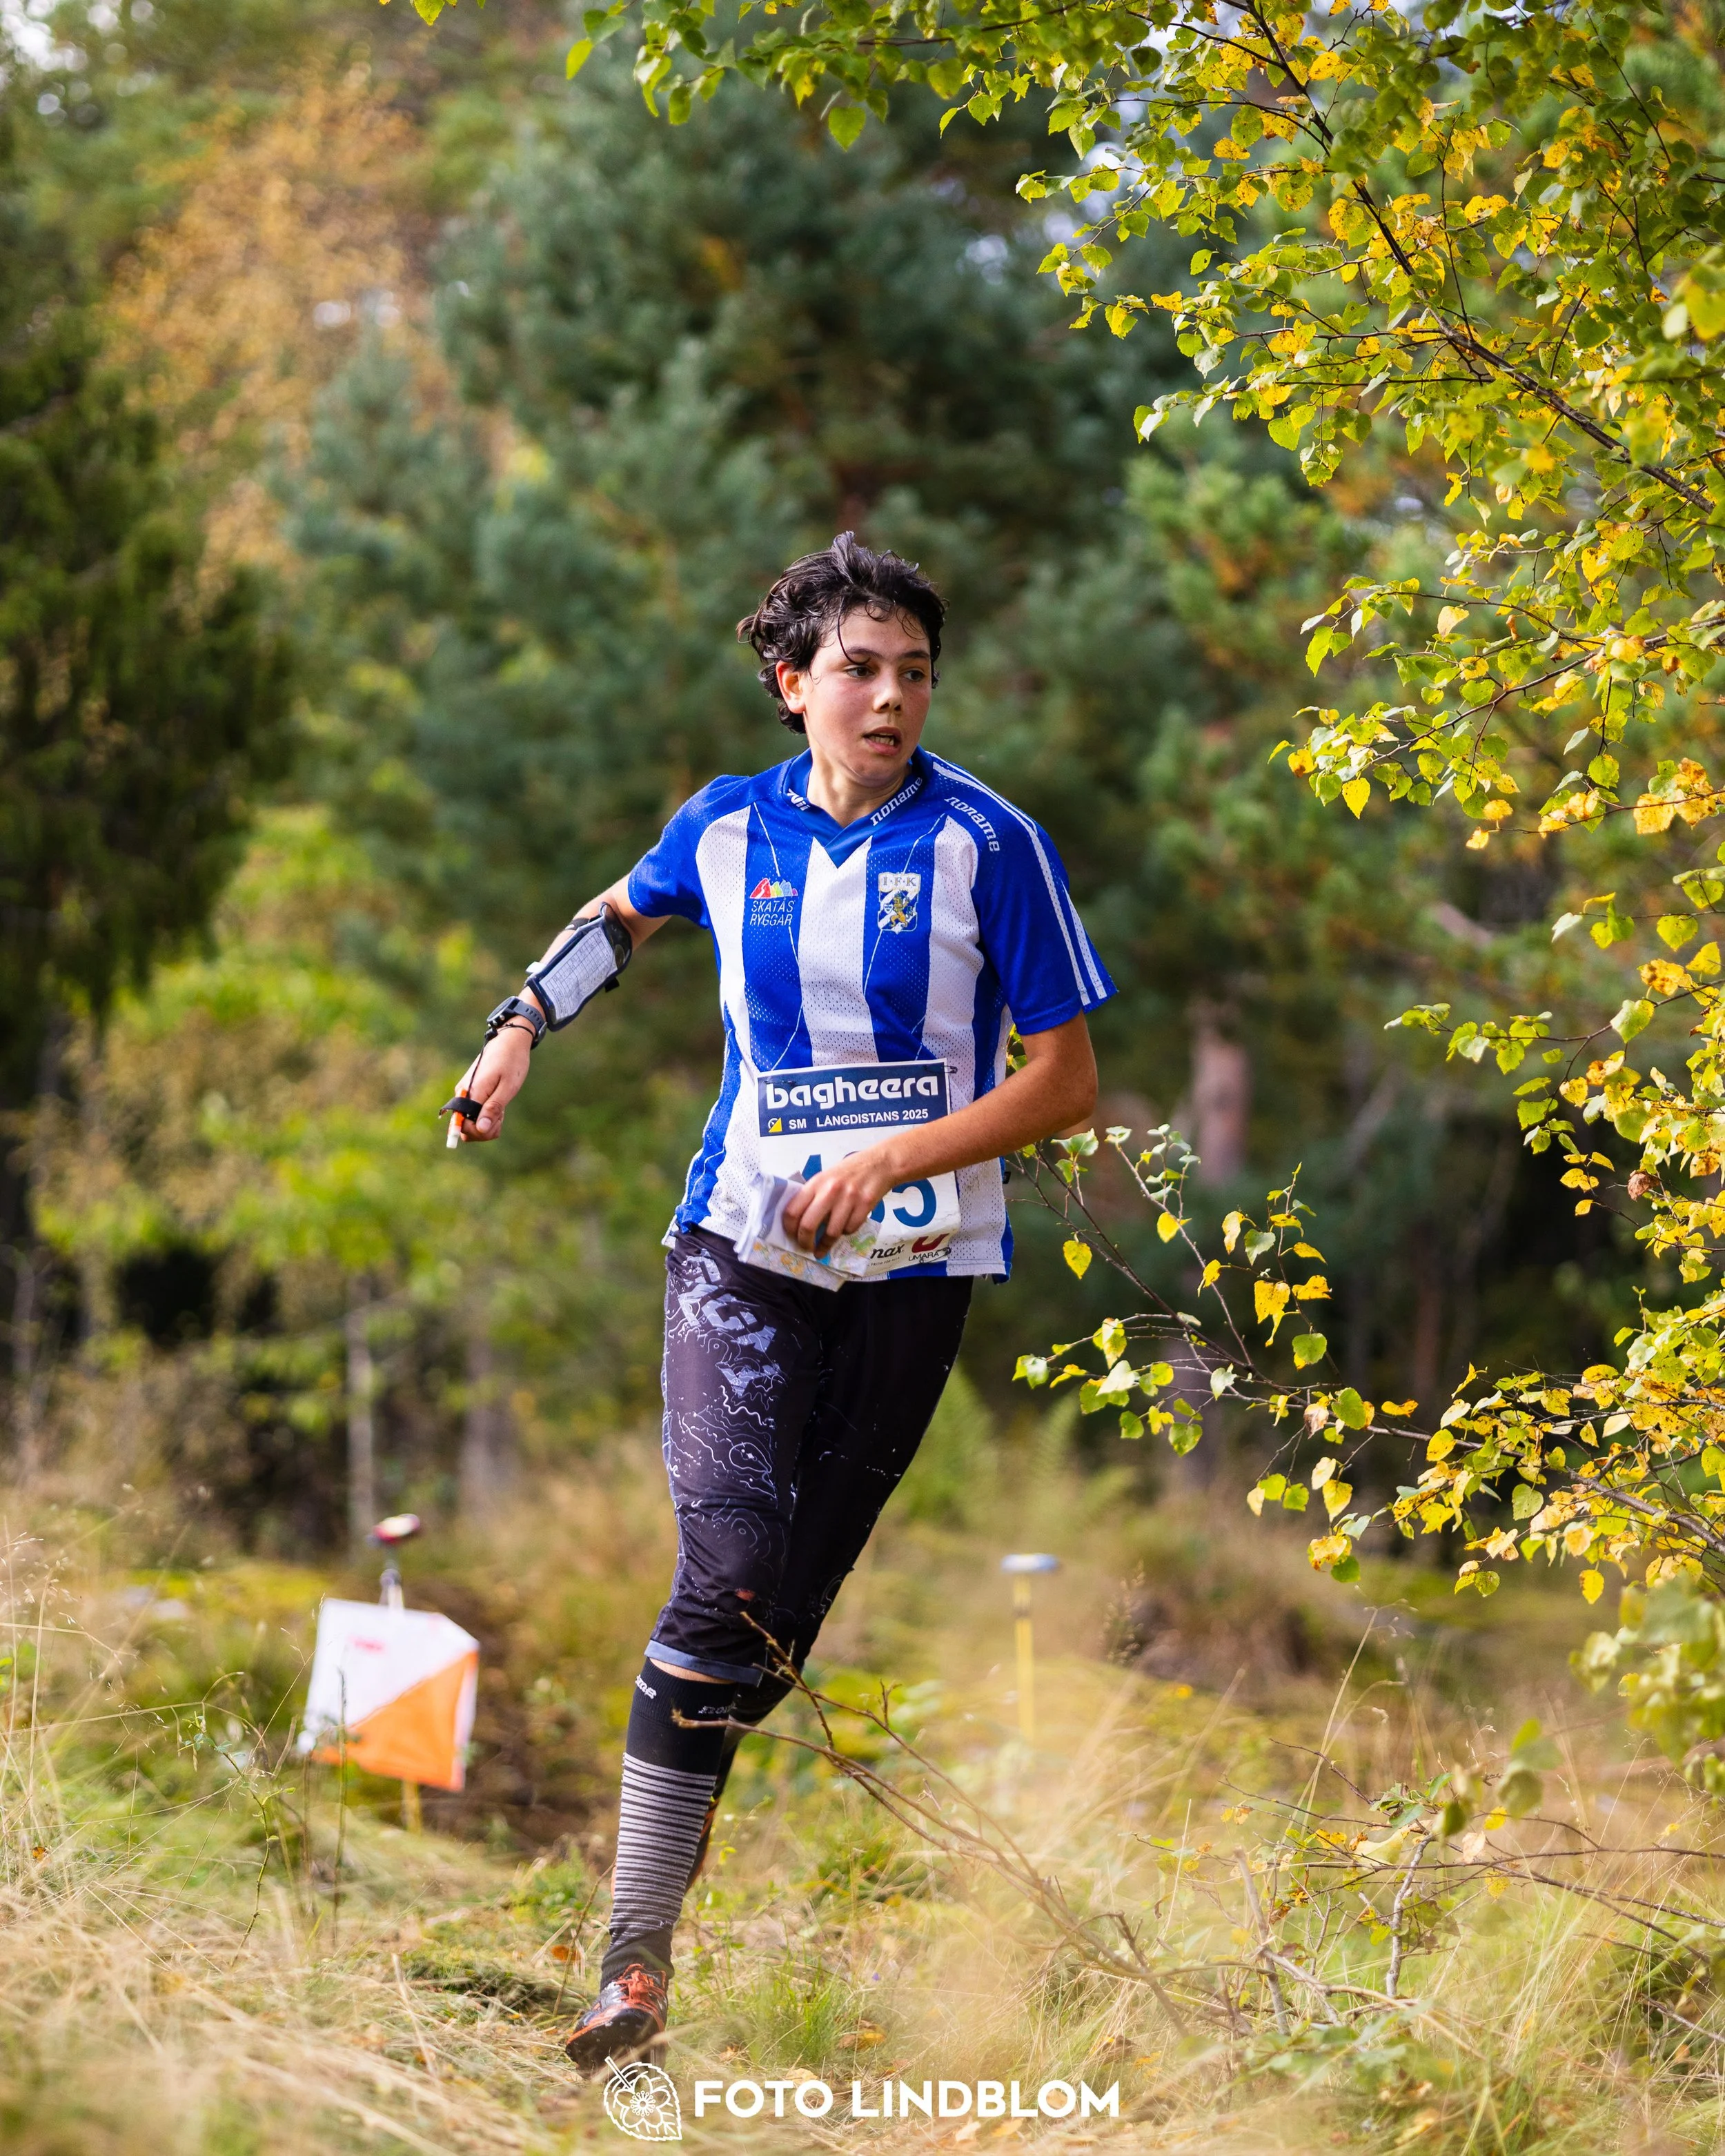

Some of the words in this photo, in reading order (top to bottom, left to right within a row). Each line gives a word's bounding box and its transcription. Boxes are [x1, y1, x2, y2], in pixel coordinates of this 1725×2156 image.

[869, 776, 923, 827] noname
[944, 796, 1000, 852] noname
[751, 897, 795, 912] SKATÅS
[749, 913, 793, 927] RYGGAR
[766, 1076, 939, 1109] bagheera
[789, 1118, 807, 1129] SM
[816, 1111, 899, 1127] LÅNGDISTANS
[902, 1108, 929, 1120] 2025
[870, 1244, 905, 1259] nax
[908, 1251, 940, 1262] UMARA
